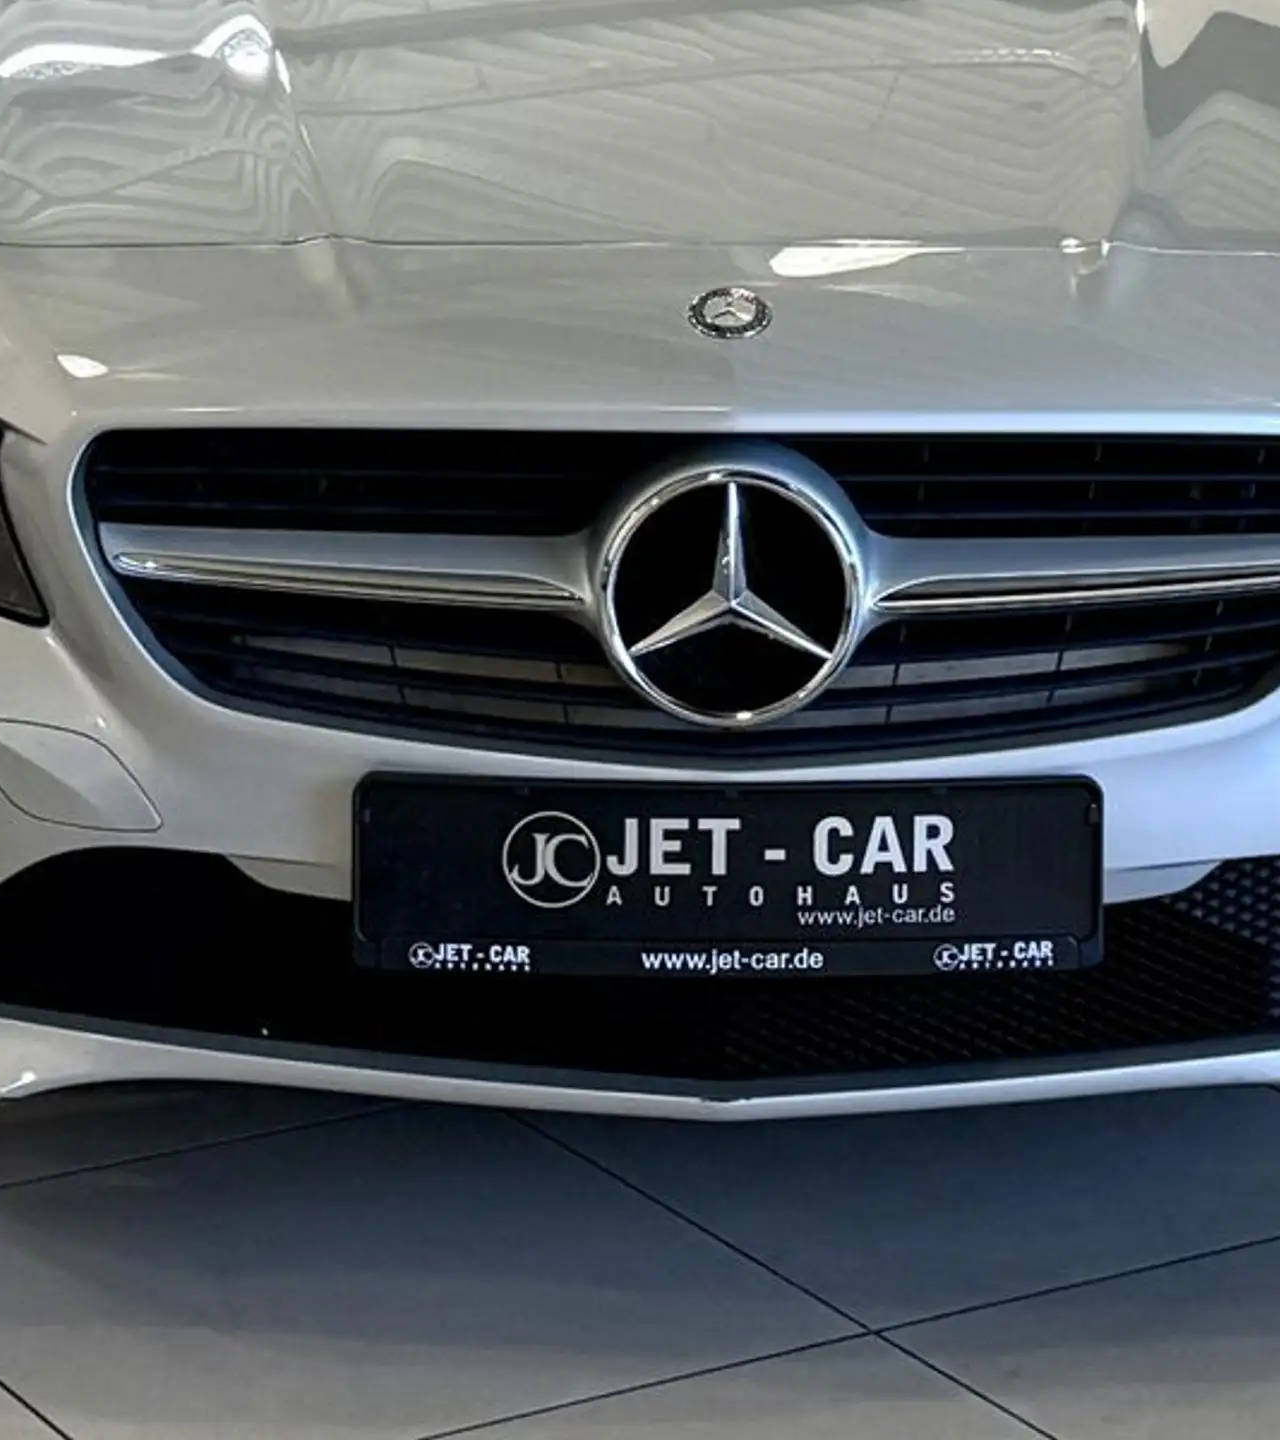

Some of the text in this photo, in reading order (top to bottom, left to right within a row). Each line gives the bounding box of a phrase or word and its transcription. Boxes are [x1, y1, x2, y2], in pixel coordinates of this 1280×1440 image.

[606, 817, 741, 876] JET
[813, 814, 955, 876] CAR
[797, 904, 956, 929] www.jet-car.de
[434, 942, 473, 962] JET
[489, 944, 531, 963] CAR
[641, 947, 824, 975] www.jet-car.de
[959, 942, 997, 961] JET
[1013, 940, 1054, 959] CAR
